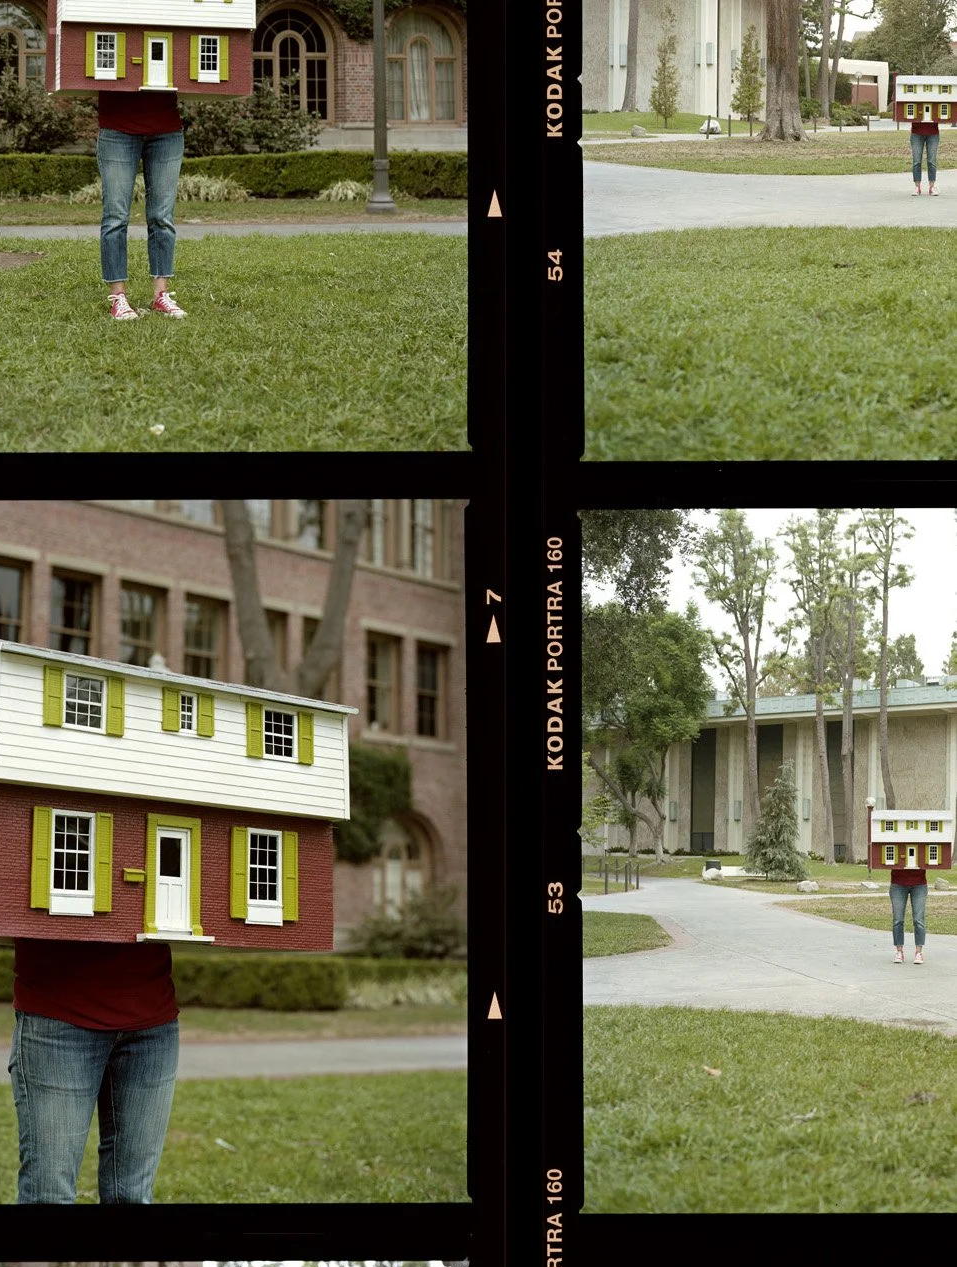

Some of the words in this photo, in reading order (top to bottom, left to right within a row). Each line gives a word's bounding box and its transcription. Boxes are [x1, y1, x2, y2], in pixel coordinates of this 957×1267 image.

[546, 45, 563, 137] KODAK
[547, 248, 564, 282] 54
[546, 536, 564, 573] 160
[486, 589, 502, 605] 7
[546, 580, 564, 671] PORTRA
[546, 678, 564, 770] KODAK
[547, 881, 564, 914] 53
[546, 1168, 564, 1205] 160
